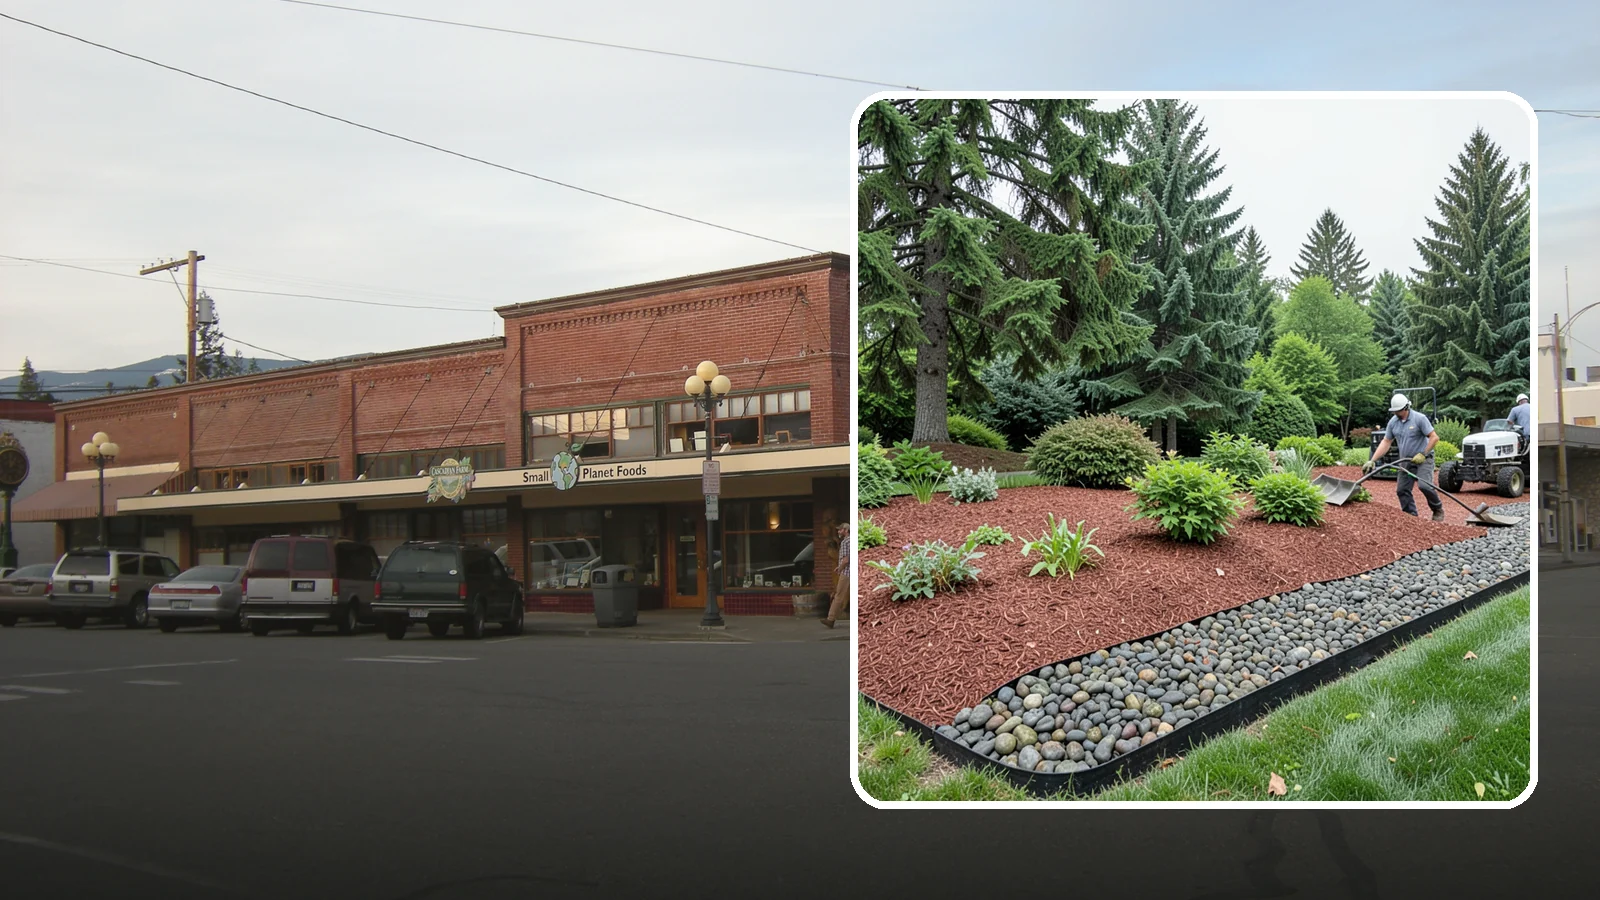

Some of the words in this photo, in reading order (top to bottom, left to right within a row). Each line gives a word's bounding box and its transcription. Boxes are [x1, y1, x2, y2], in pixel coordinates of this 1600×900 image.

[523, 471, 549, 483] Small
[583, 467, 614, 479] Planet
[617, 464, 647, 476] Foods
